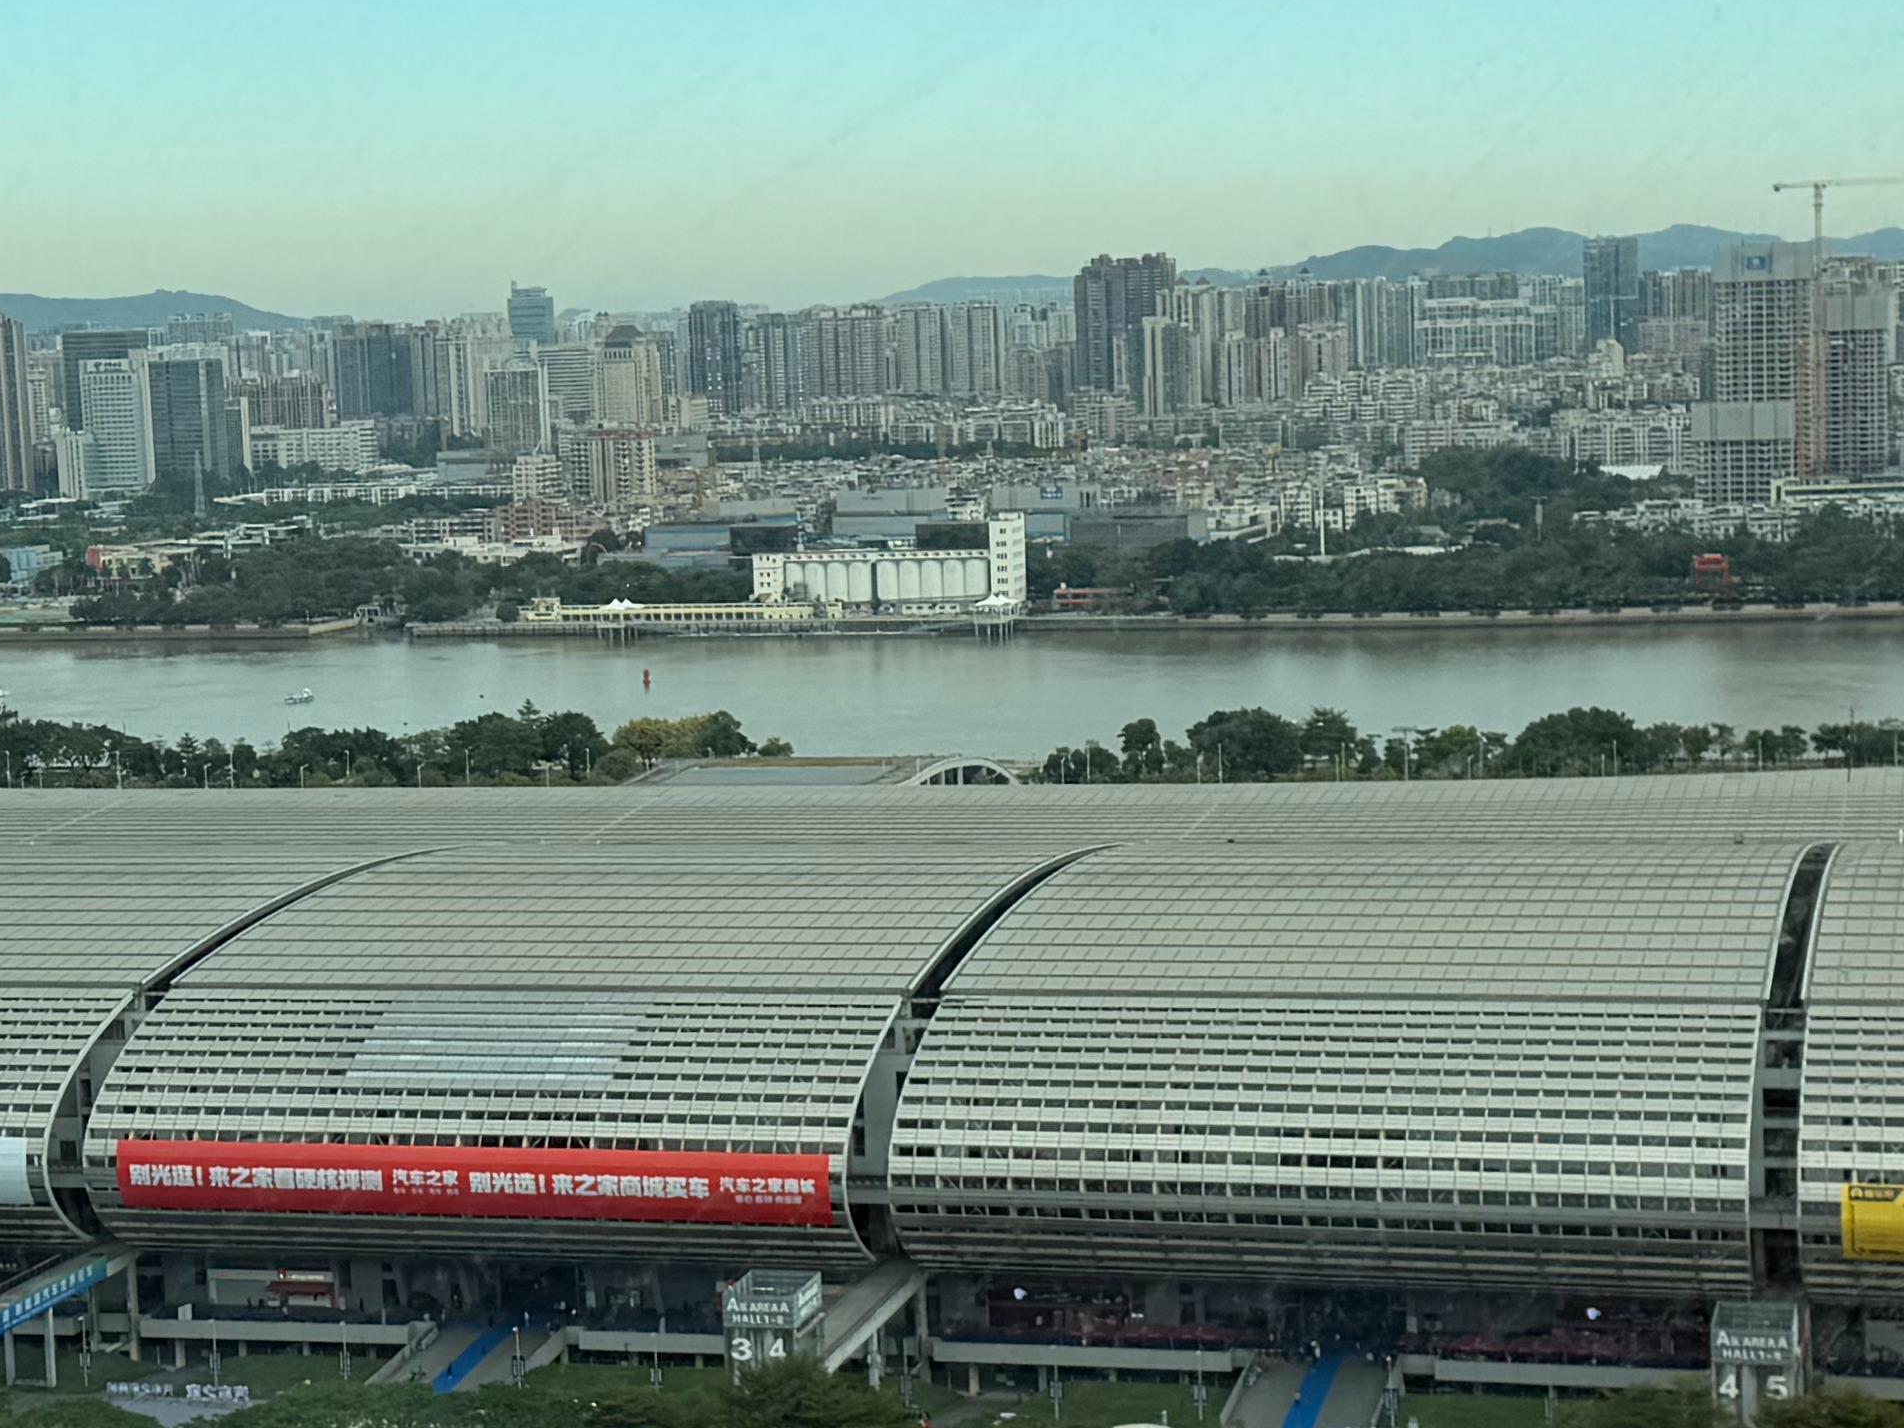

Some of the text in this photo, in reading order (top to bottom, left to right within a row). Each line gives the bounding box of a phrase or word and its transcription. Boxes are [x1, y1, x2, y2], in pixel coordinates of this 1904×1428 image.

[392, 1169, 459, 1186] 汽车之家
[731, 1338, 787, 1361] 3 4
[1719, 1373, 1788, 1400] 4 5
